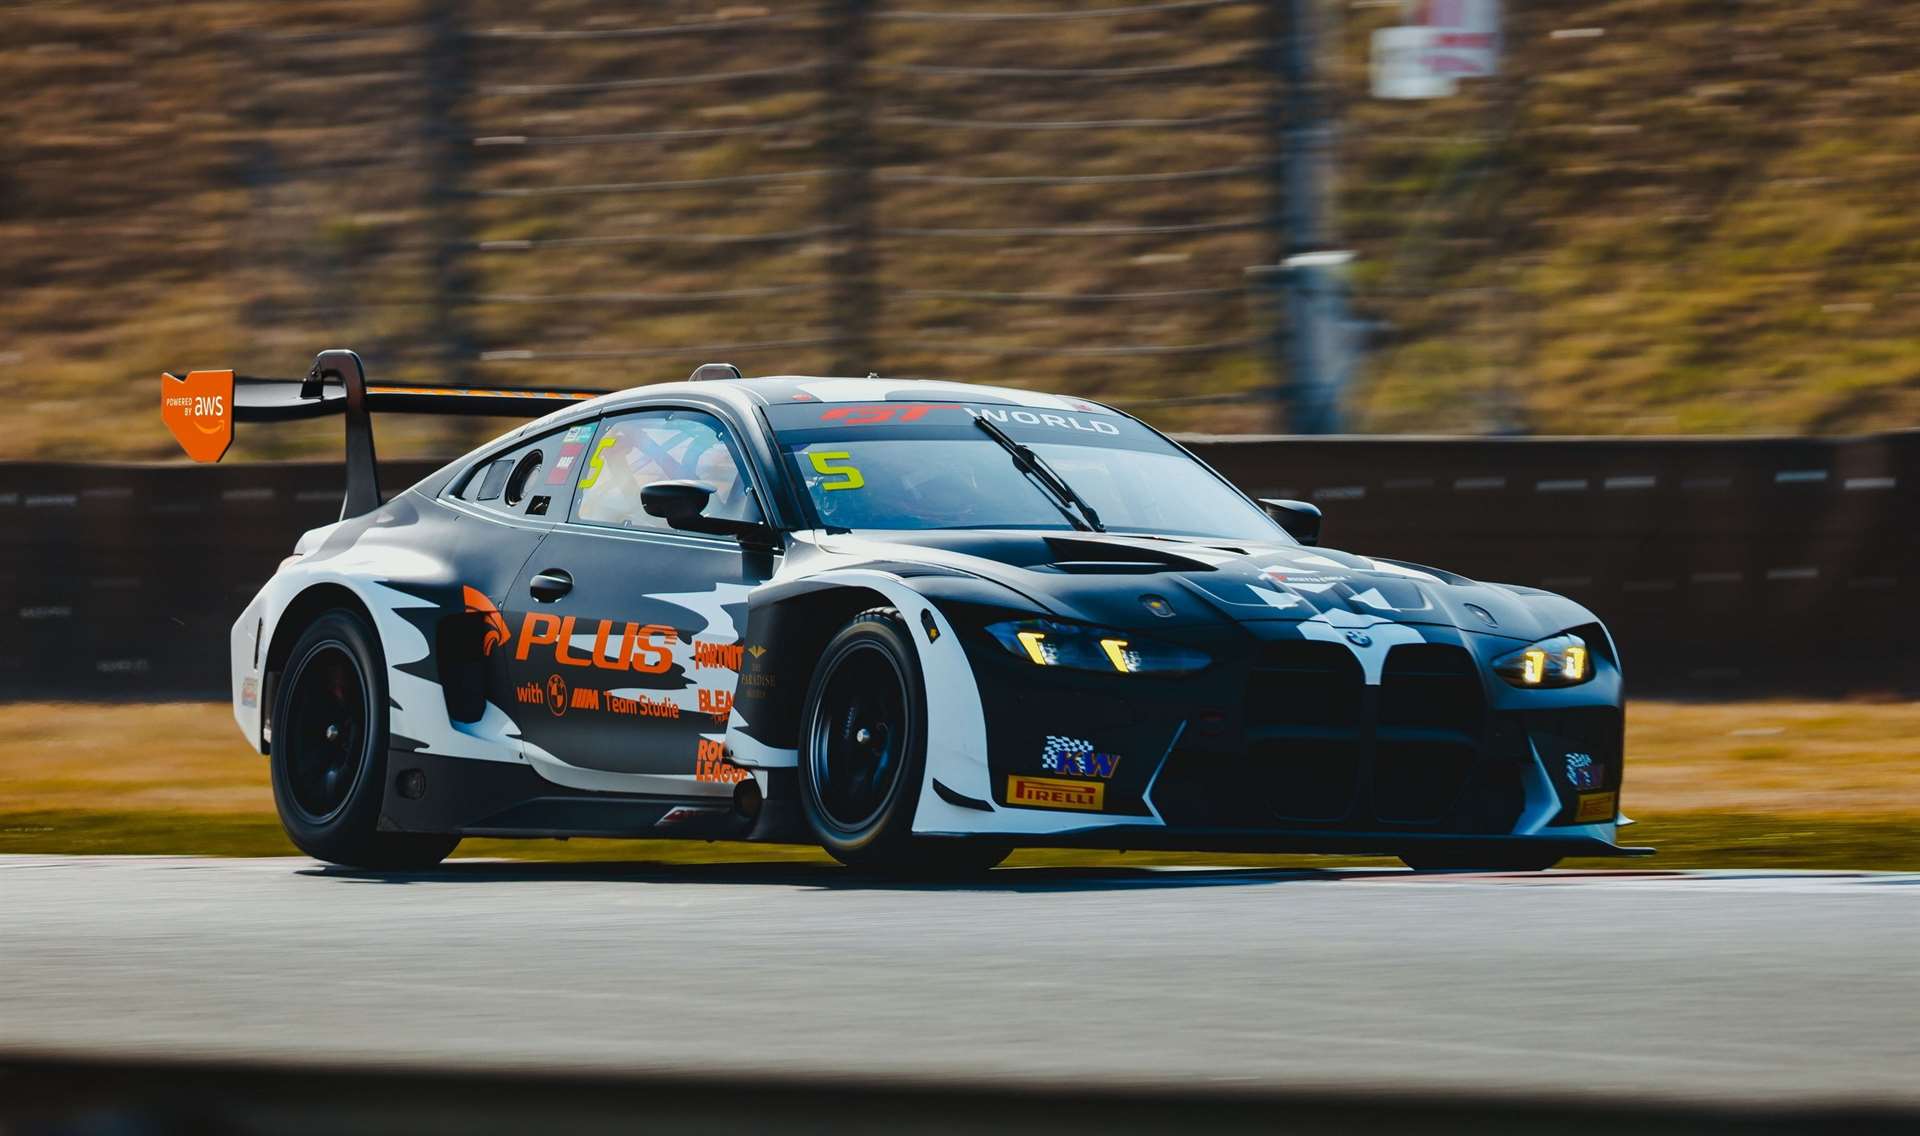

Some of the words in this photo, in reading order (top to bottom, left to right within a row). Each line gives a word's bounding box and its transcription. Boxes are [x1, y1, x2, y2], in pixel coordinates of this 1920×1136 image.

[166, 397, 192, 407] POWERED
[184, 407, 193, 416] BY
[194, 396, 224, 416] aws
[819, 404, 960, 425] GT
[963, 407, 1121, 435] WORLD
[577, 437, 616, 488] 5
[808, 451, 864, 491] 5
[514, 611, 679, 674] PLUS
[516, 682, 544, 704] with
[604, 690, 637, 717] Team
[639, 694, 680, 720] Studie
[1055, 750, 1120, 778] KW
[1016, 781, 1097, 805] PIRELLI
